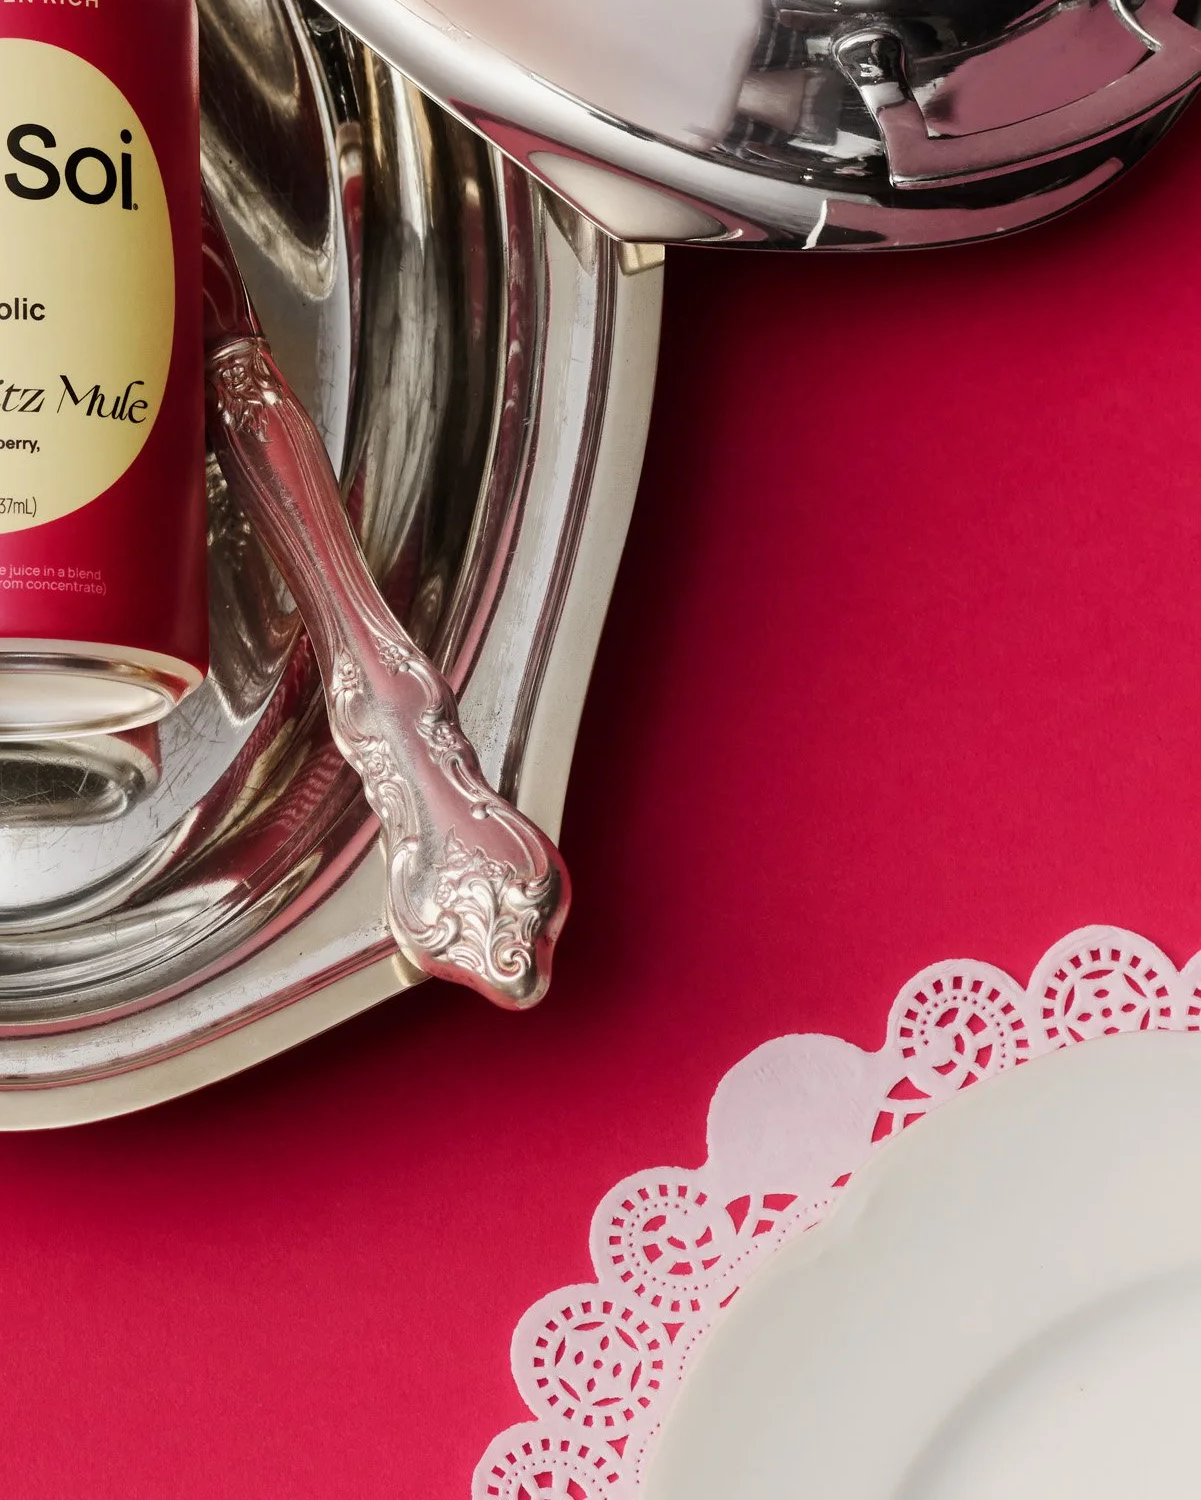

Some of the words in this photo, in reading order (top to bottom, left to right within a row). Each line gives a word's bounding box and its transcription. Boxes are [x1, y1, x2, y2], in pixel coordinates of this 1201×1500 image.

[57, 374, 149, 424] Mule
[8, 564, 41, 579] juice
[44, 565, 55, 577] in
[57, 568, 65, 578] a
[67, 567, 101, 581] blend
[26, 579, 107, 596] concentrate)
